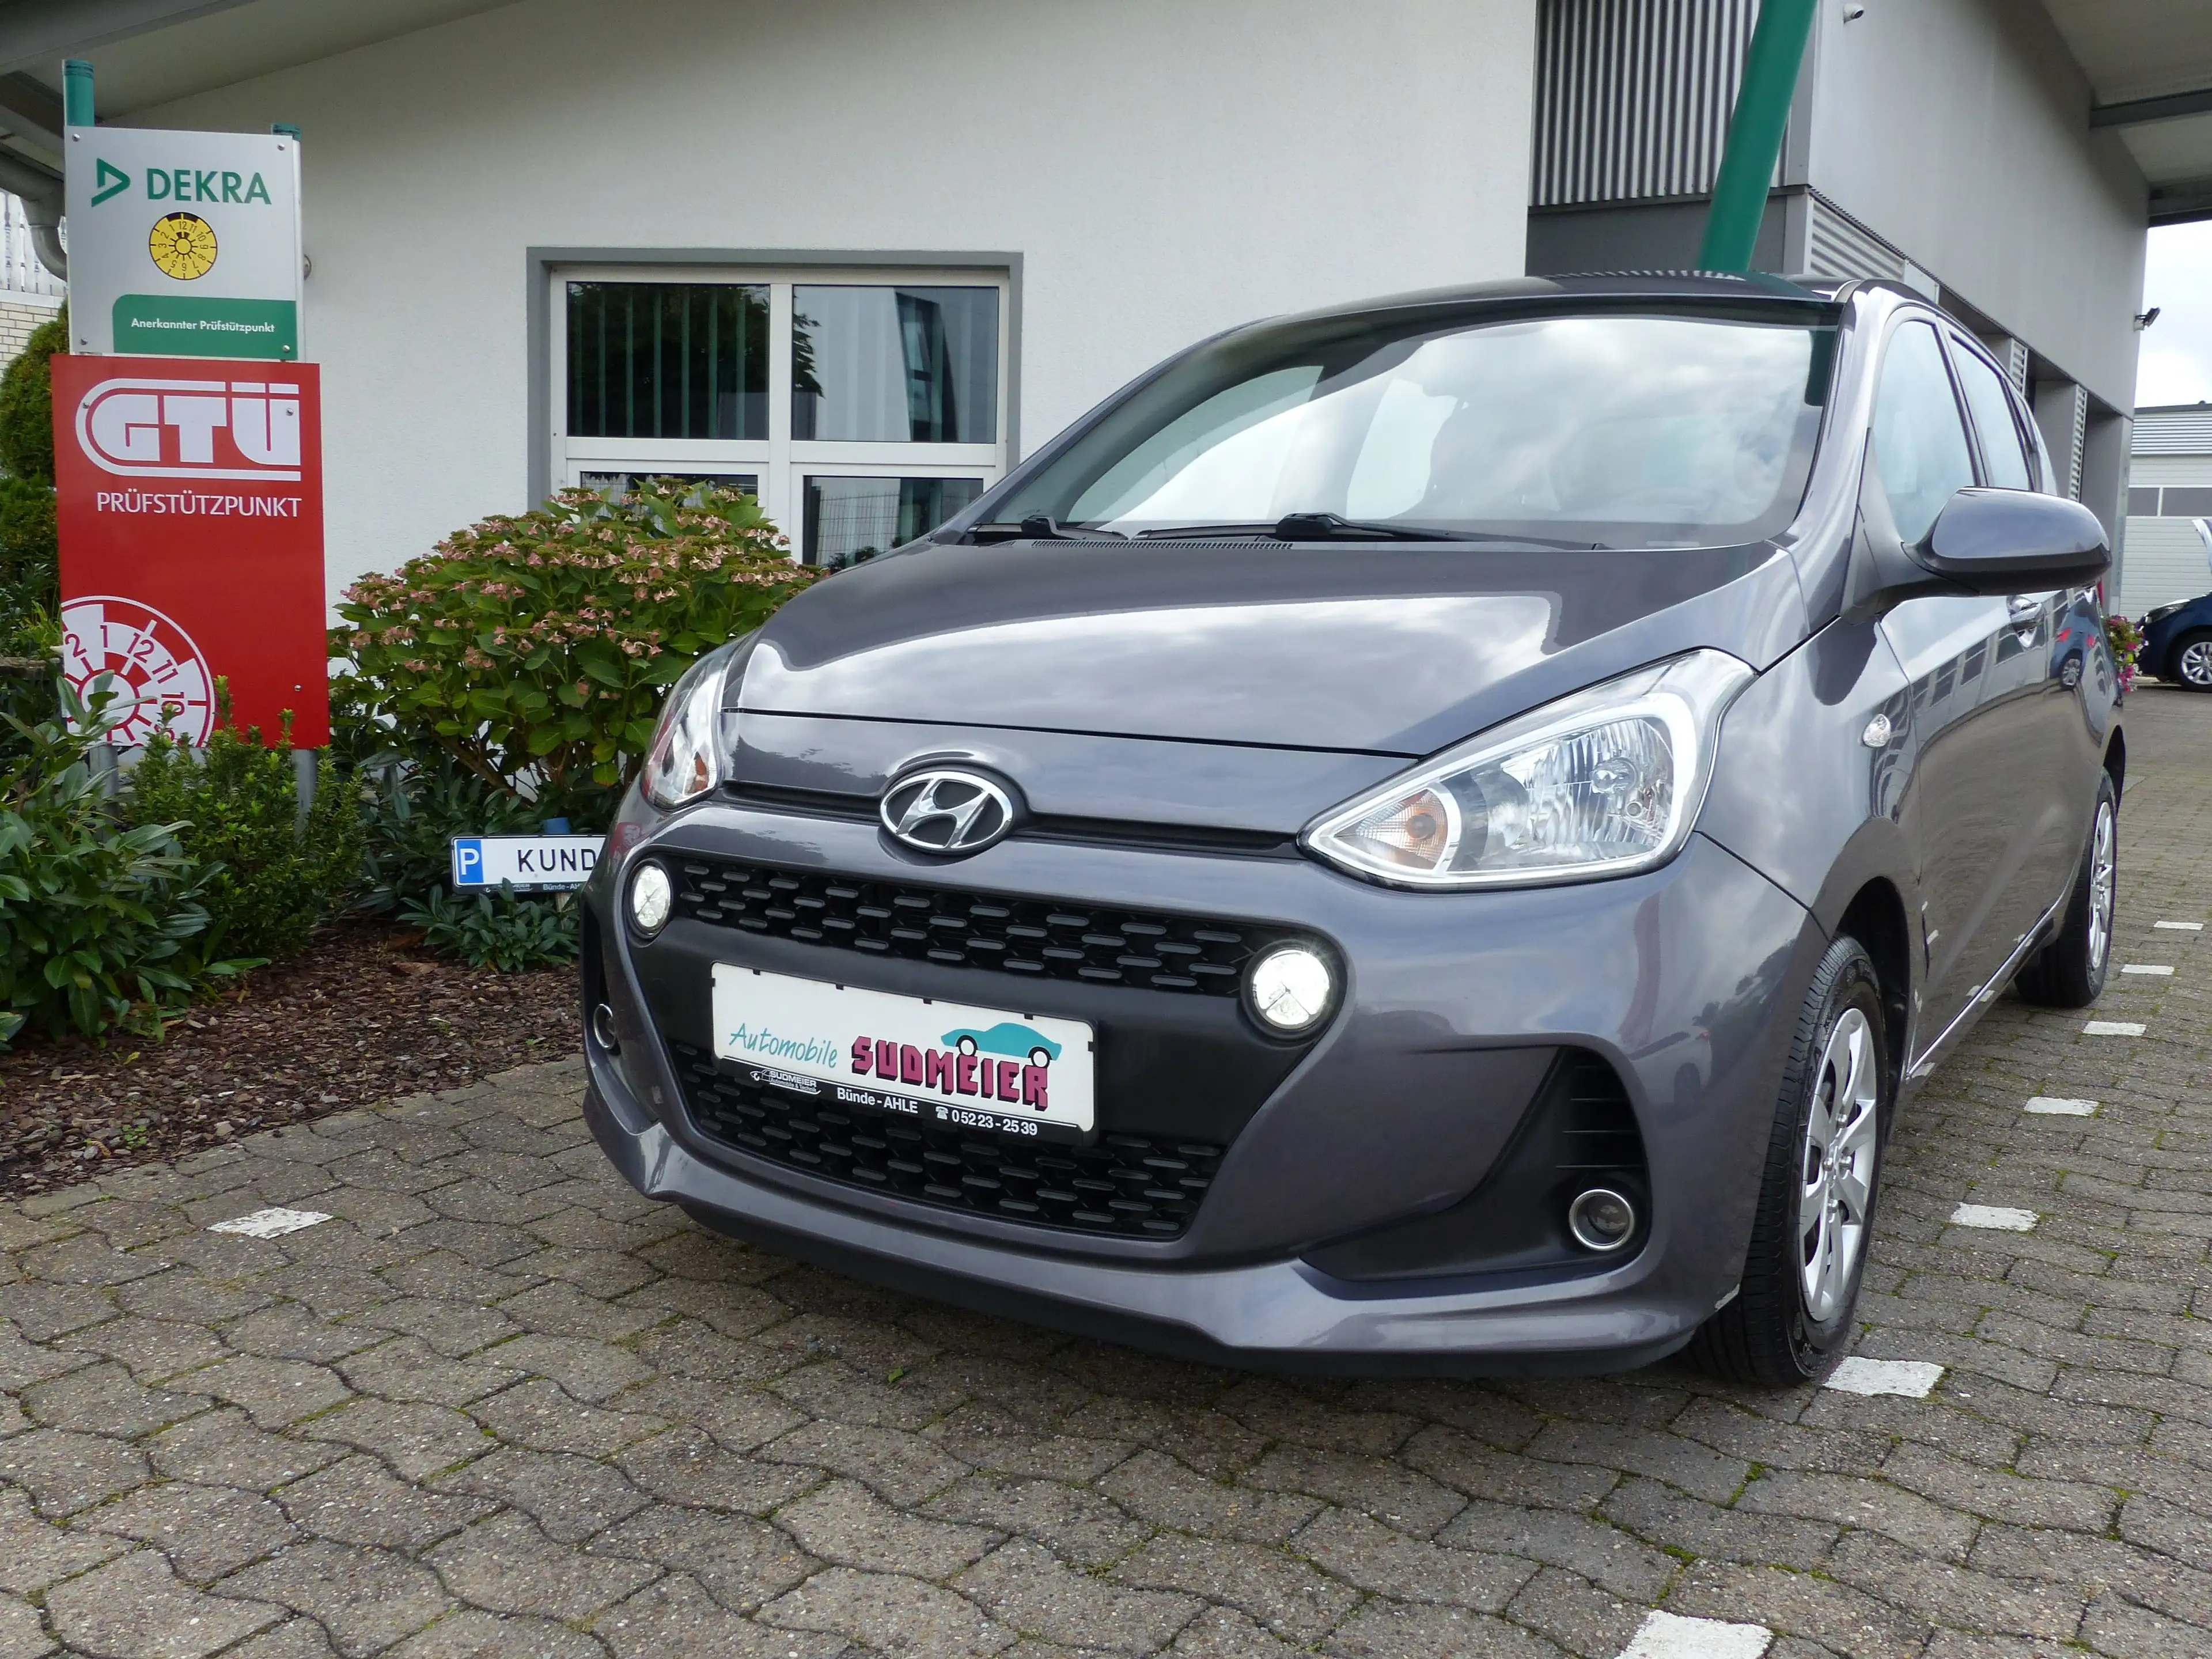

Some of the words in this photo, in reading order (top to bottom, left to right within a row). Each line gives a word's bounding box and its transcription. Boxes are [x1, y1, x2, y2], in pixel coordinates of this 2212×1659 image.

[147, 168, 272, 205] DEKRA
[179, 221, 187, 230] 12
[190, 224, 197, 233] 11
[196, 232, 206, 242] 10
[170, 260, 177, 268] 5
[131, 317, 198, 330] Anerkannter
[200, 320, 276, 334] Prüfstützpunkt
[90, 381, 301, 467] GTÜ
[97, 488, 302, 518] PRÜFSTÜTZPUNKT
[65, 634, 87, 658] 2
[100, 624, 108, 648] 1
[127, 632, 155, 664] 12
[152, 658, 179, 684] 11
[161, 691, 185, 716] 10
[460, 848, 480, 876] P
[517, 849, 596, 873] KUND
[729, 1022, 838, 1069] Automobile
[769, 1070, 817, 1088] SUDMEIER
[851, 1036, 1048, 1112] SUDMEIER
